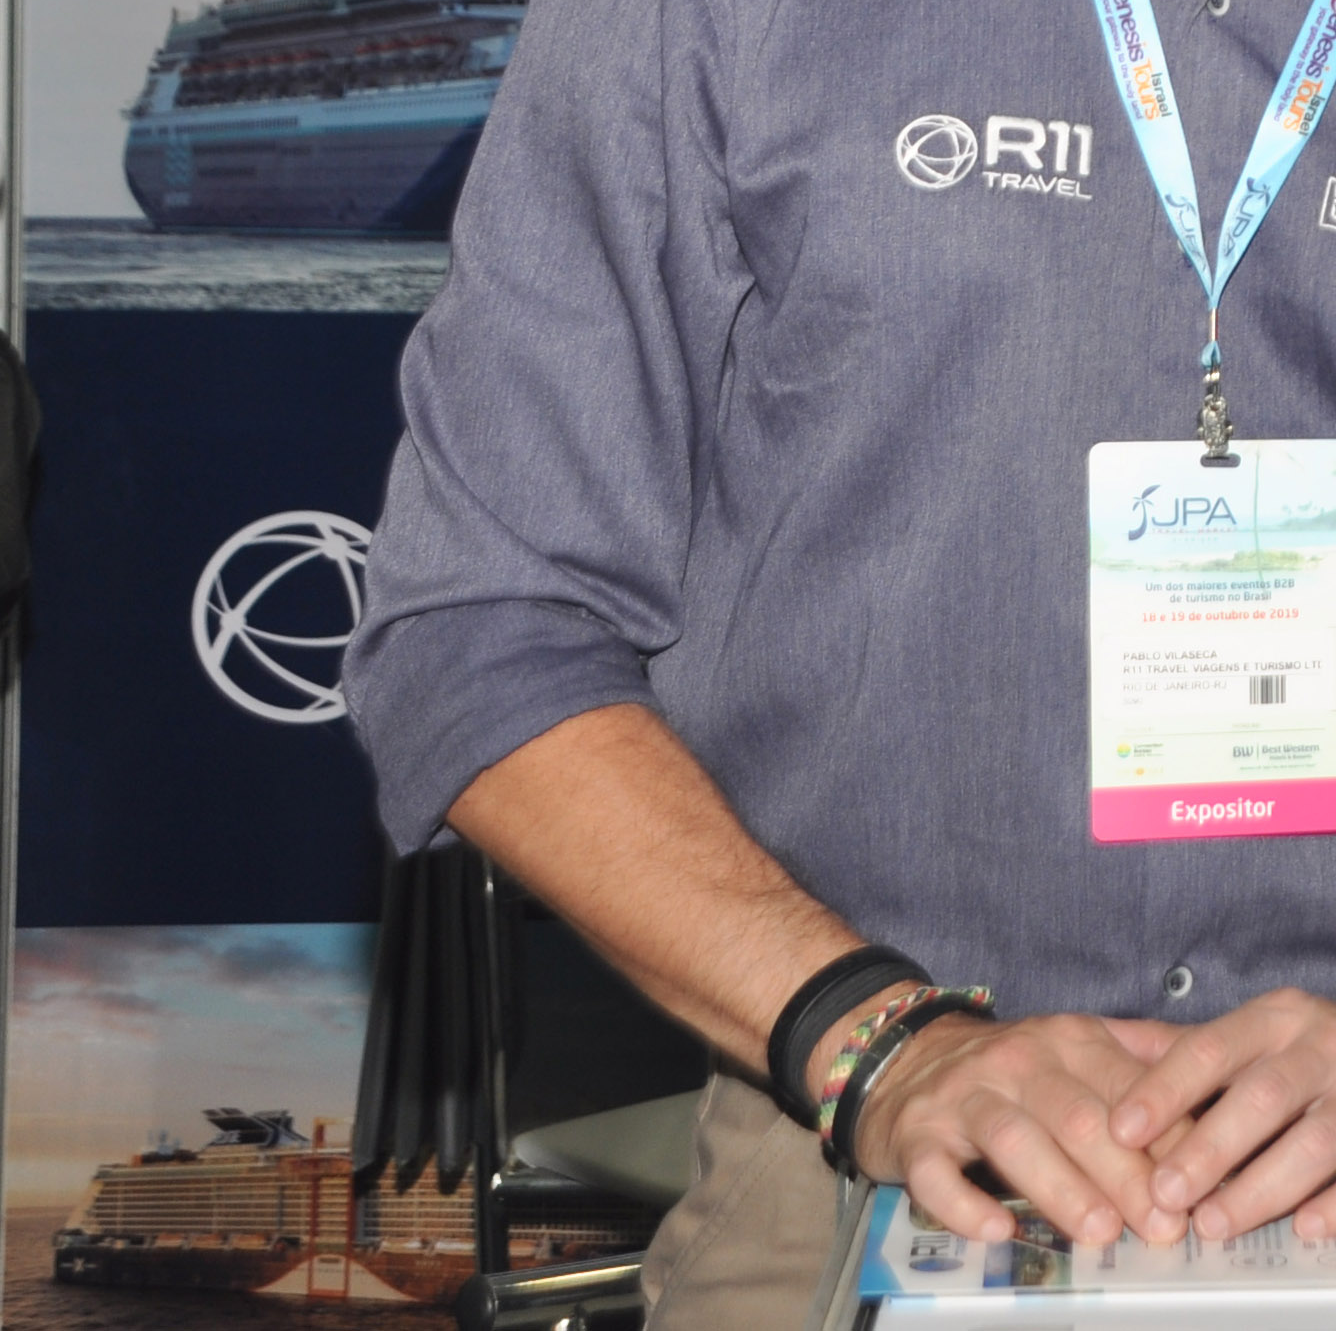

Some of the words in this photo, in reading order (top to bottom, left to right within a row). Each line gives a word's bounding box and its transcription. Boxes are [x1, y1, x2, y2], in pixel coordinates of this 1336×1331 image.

[1134, 60, 1161, 121] Tours
[1151, 72, 1173, 118] Israel
[1283, 78, 1325, 131] Tours
[1299, 94, 1326, 137] Israel
[986, 115, 1093, 176] R11
[982, 171, 1093, 200] TRAVEL
[1151, 497, 1237, 526] JPA
[1145, 582, 1163, 592] Um
[1165, 582, 1184, 592] dos
[1186, 581, 1228, 591] maiores
[1230, 580, 1271, 590] eventos
[1274, 578, 1295, 589] B2B
[1169, 593, 1182, 603] de
[1186, 592, 1225, 603] turismo
[1227, 593, 1241, 601] no
[1243, 591, 1272, 602] Brasil
[1142, 612, 1156, 622] 18
[1171, 611, 1185, 621] 19
[1188, 611, 1202, 621] de
[1205, 610, 1250, 621] outubro
[1252, 609, 1266, 620] de
[1269, 608, 1299, 620] 2019
[1147, 664, 1189, 674] TRAVEL
[1193, 662, 1240, 673] VIAGENS
[1254, 660, 1302, 671] TURISMO
[1283, 744, 1320, 754] Western
[1170, 797, 1276, 825] Expositor
